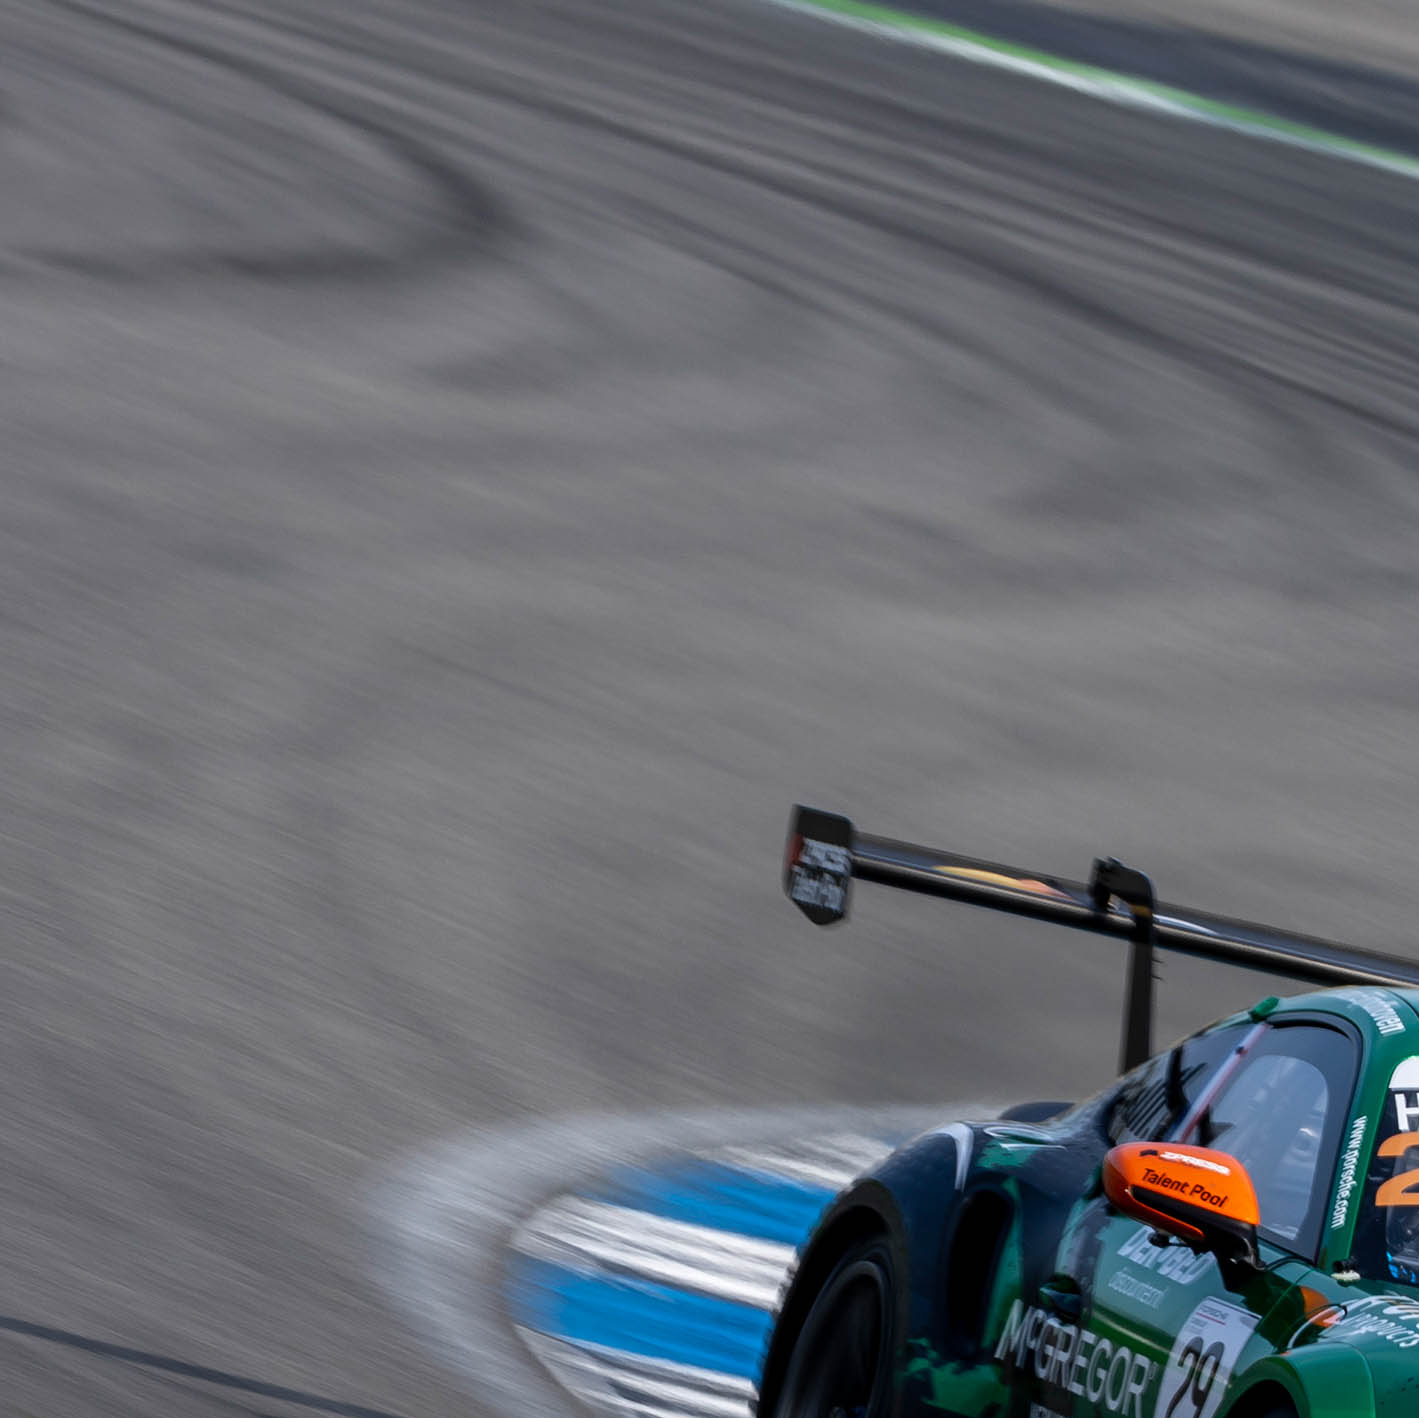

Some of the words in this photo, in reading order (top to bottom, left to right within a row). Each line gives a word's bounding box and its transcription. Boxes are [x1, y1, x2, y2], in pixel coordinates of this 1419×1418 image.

[1142, 1168, 1189, 1194] Talent
[1189, 1184, 1228, 1208] Pool
[1331, 1115, 1367, 1229] www.porsche.com
